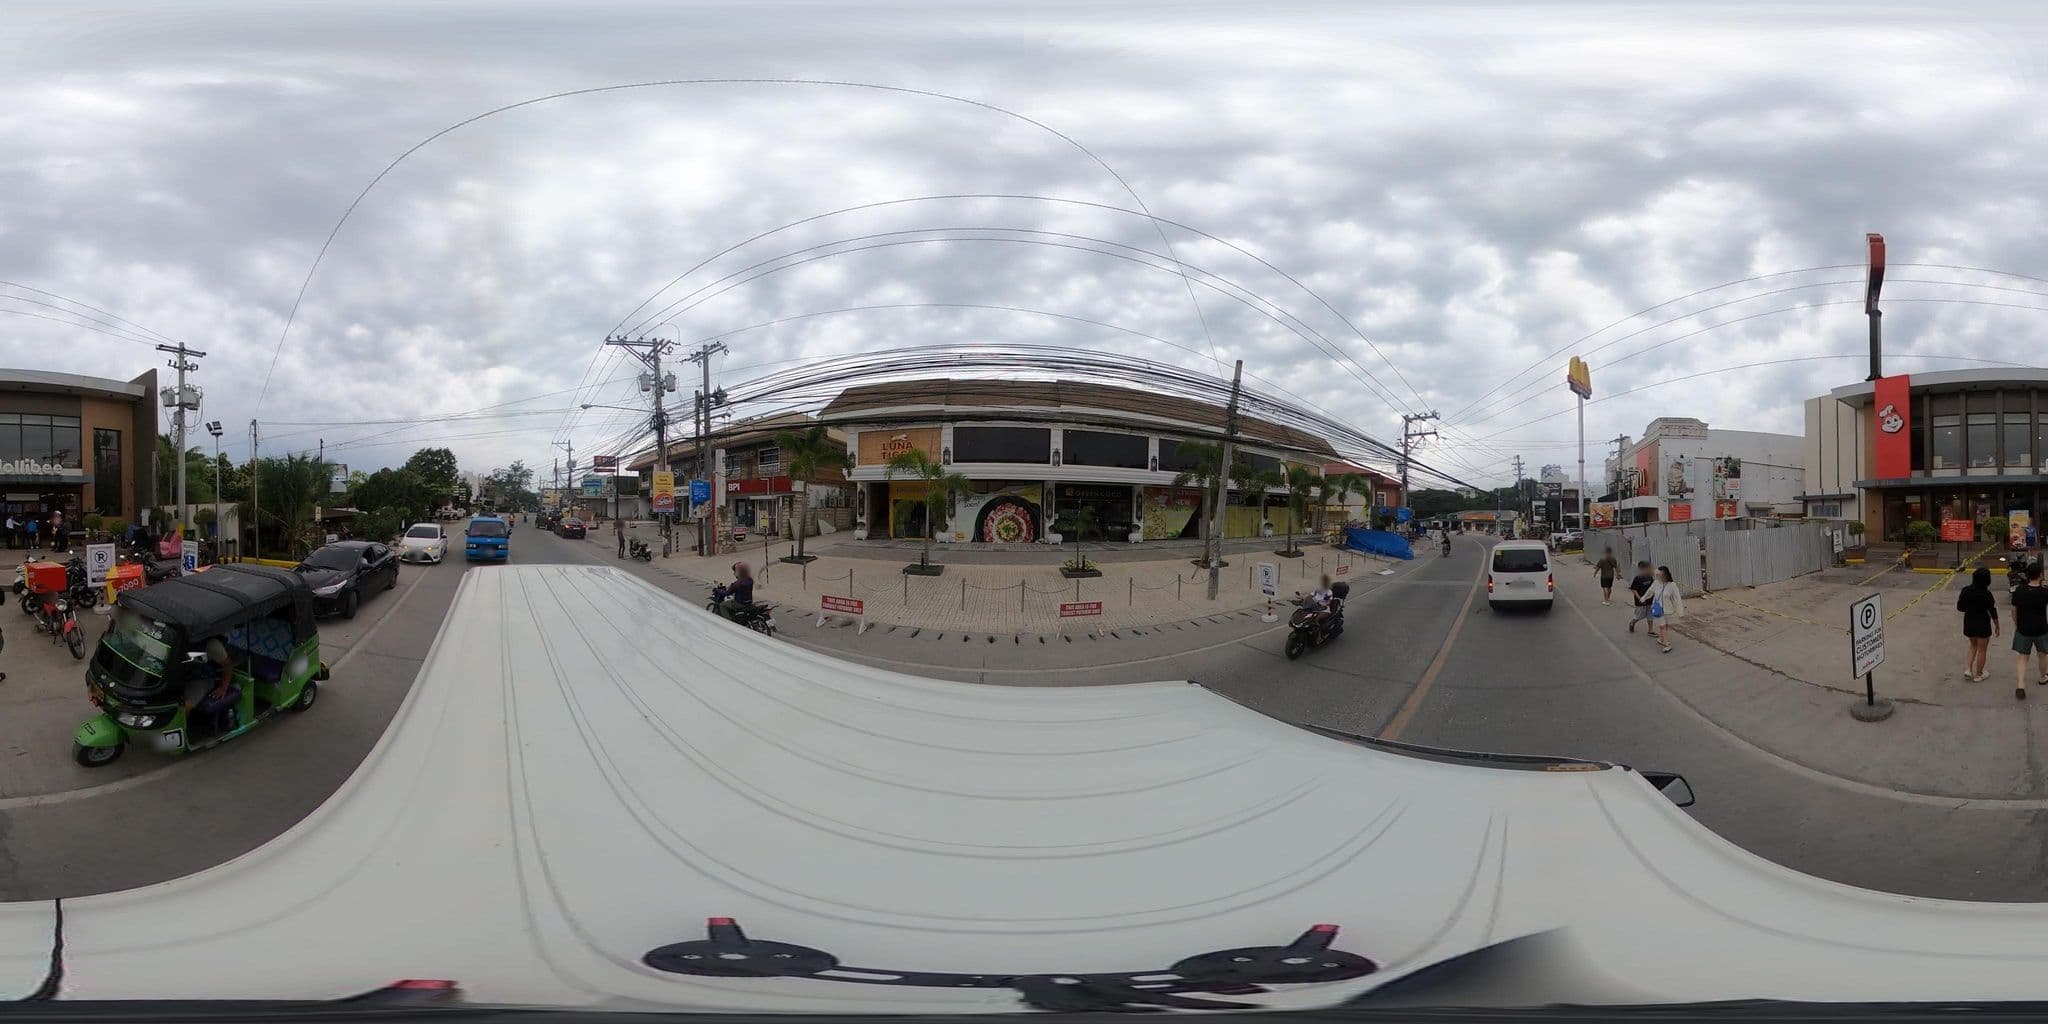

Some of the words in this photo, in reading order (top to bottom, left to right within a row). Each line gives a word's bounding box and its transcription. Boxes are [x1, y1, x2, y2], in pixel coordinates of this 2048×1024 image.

[881, 441, 914, 451] LUNA
[0, 458, 64, 475] ollibee
[727, 483, 741, 491] BPI
[1865, 608, 1872, 624] P
[1856, 631, 1874, 645] PARKING
